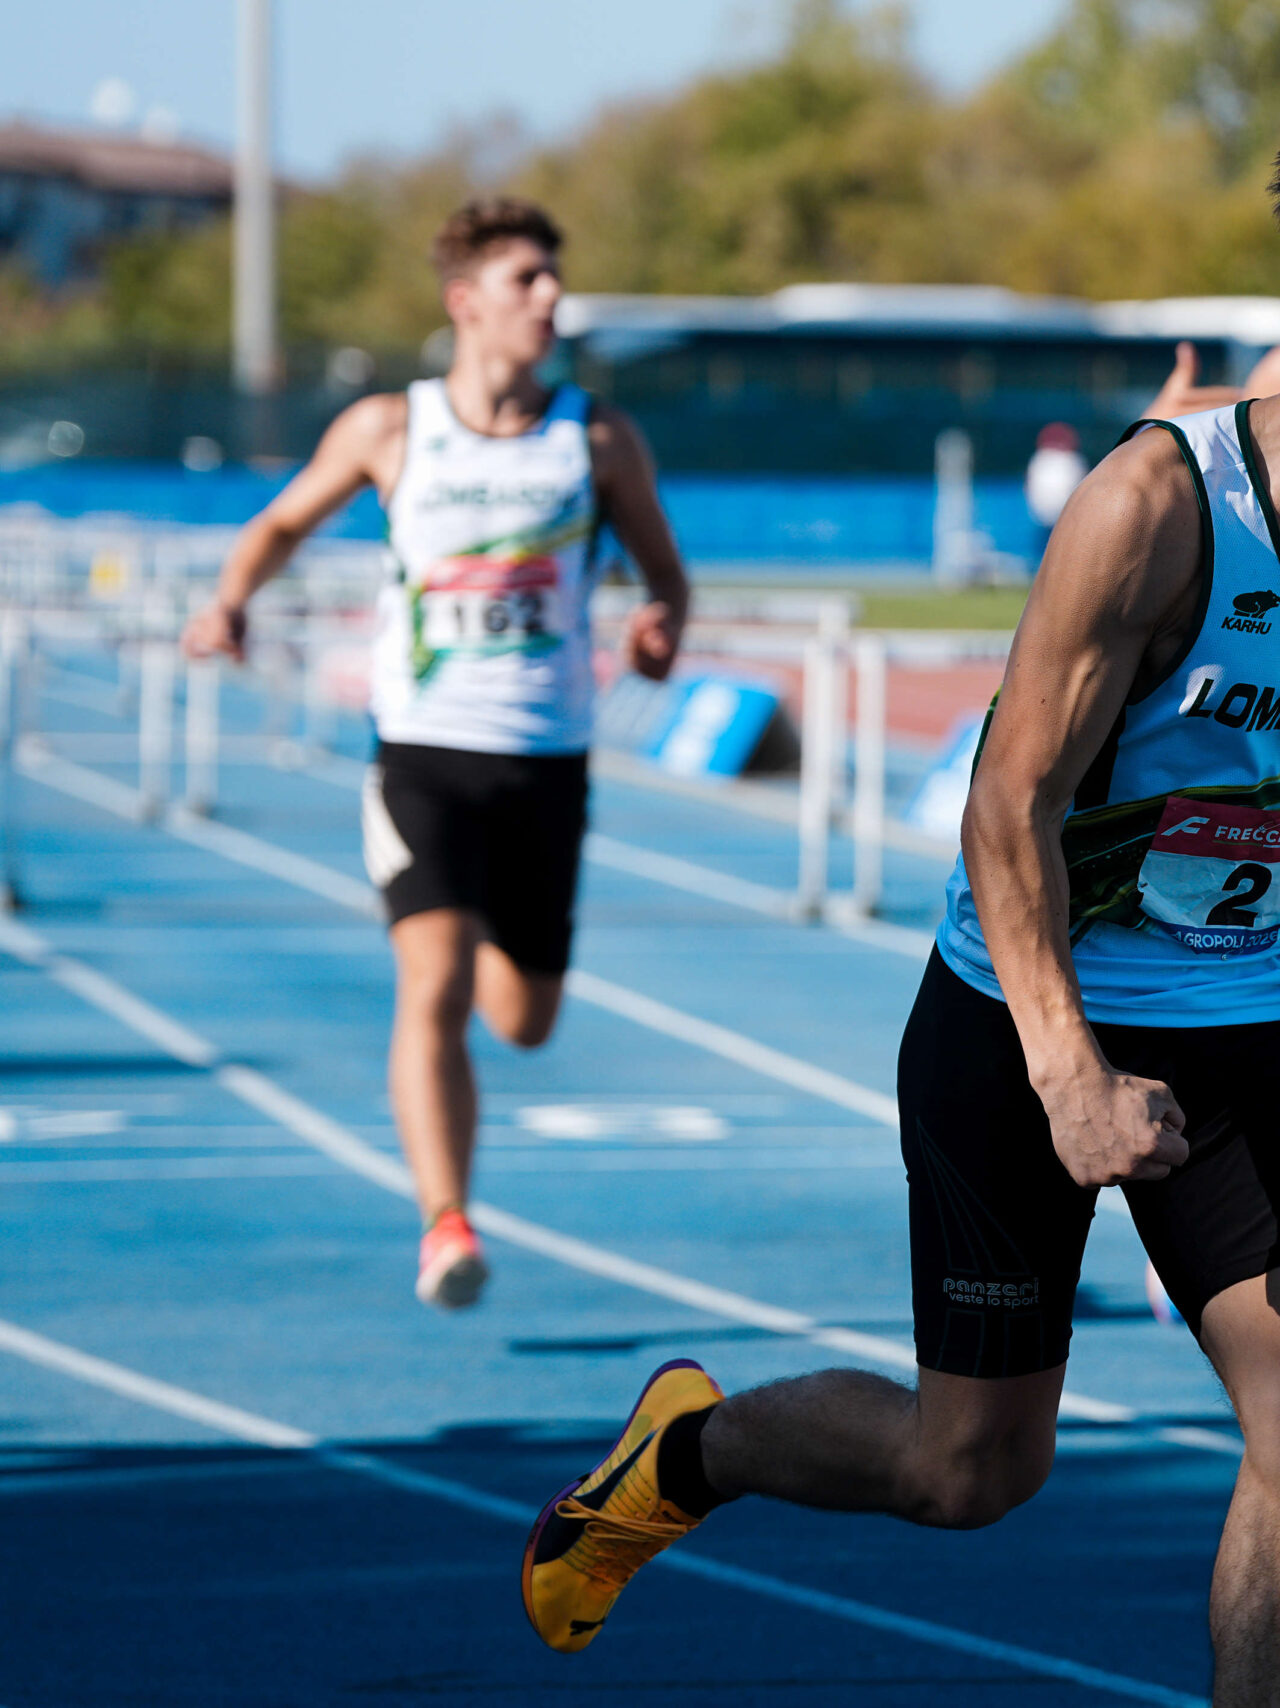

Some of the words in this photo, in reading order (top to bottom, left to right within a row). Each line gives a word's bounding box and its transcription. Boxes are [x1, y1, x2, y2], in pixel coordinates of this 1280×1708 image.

[1221, 616, 1272, 635] KARHU
[1205, 863, 1272, 927] 2
[943, 1277, 1039, 1296] panzeri
[949, 1292, 984, 1304] veste
[987, 1295, 1000, 1306] lo
[1003, 1294, 1039, 1310] sport
